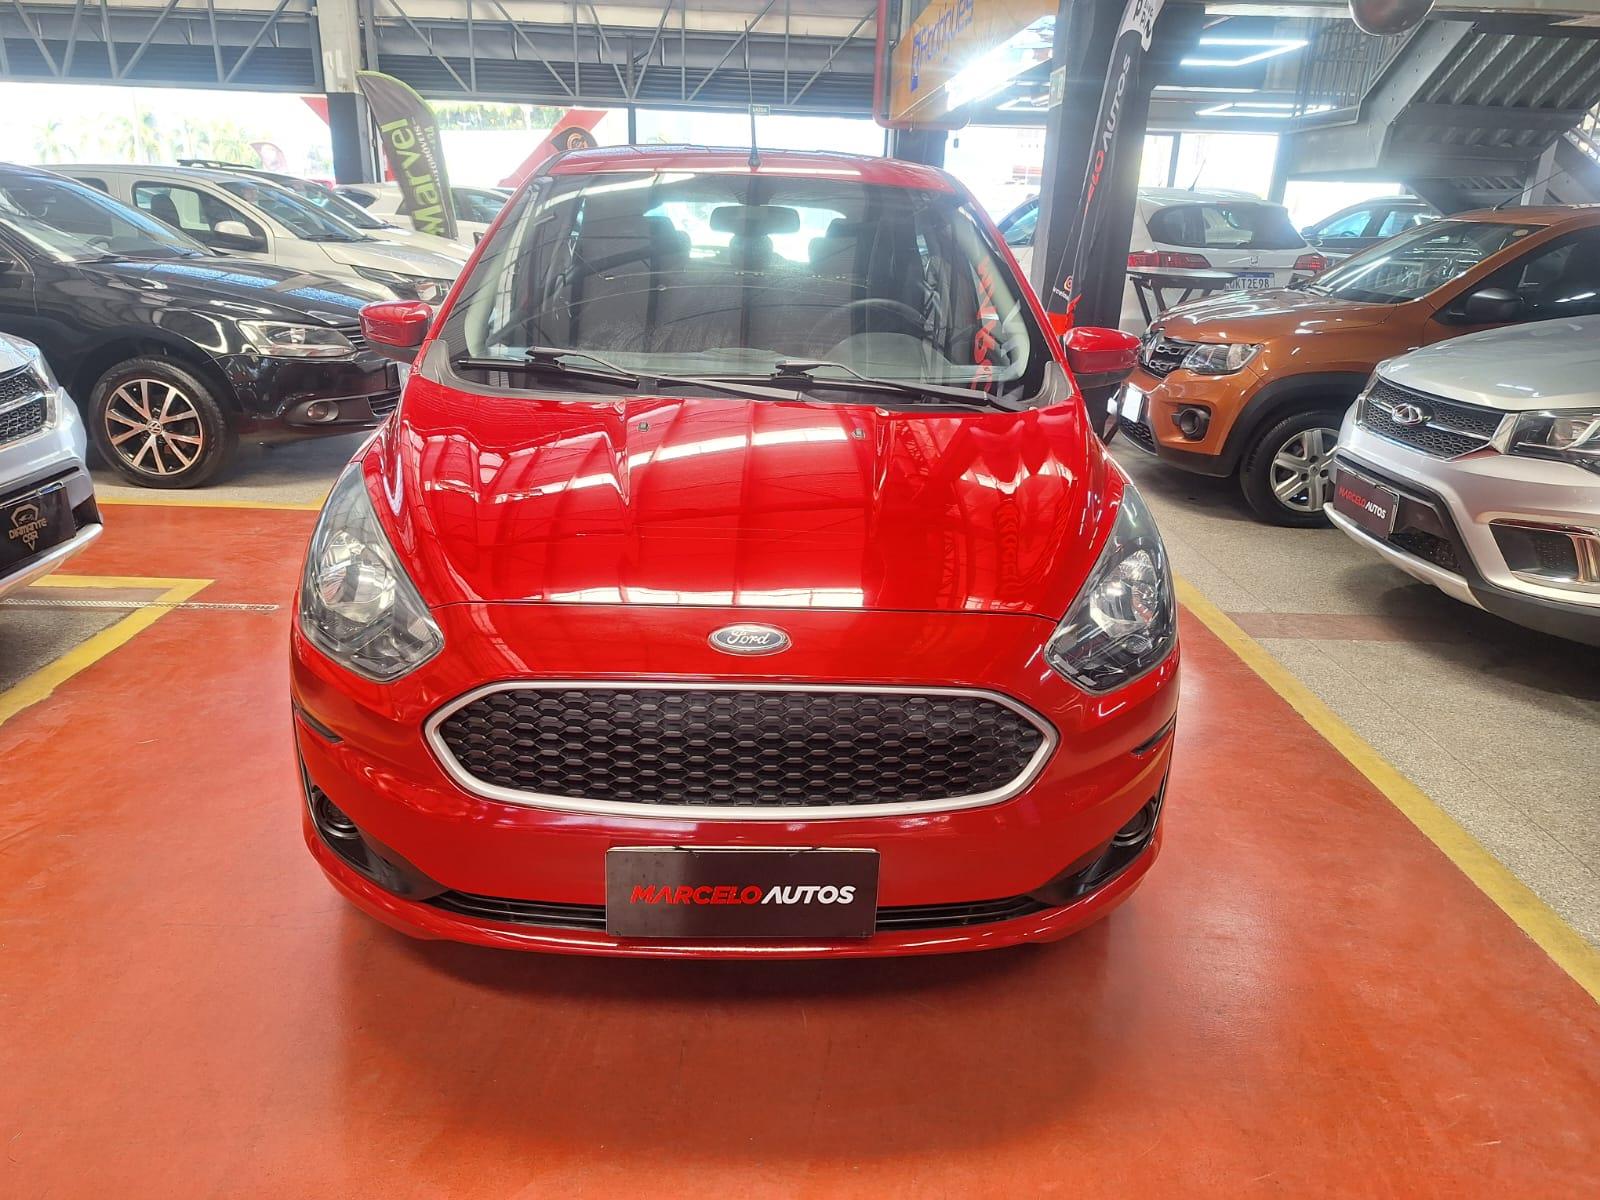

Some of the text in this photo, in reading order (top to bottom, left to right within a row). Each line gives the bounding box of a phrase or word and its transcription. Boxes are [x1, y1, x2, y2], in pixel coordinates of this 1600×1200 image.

[1103, 53, 1131, 152] AUTOS
[381, 118, 445, 236] Marvel
[1338, 486, 1387, 519] MARCELO AUTOS
[9, 518, 48, 539] DIAMANTE
[22, 530, 39, 543] CAR
[727, 630, 771, 645] Ford
[629, 885, 857, 905] MARCELO AUTOS
